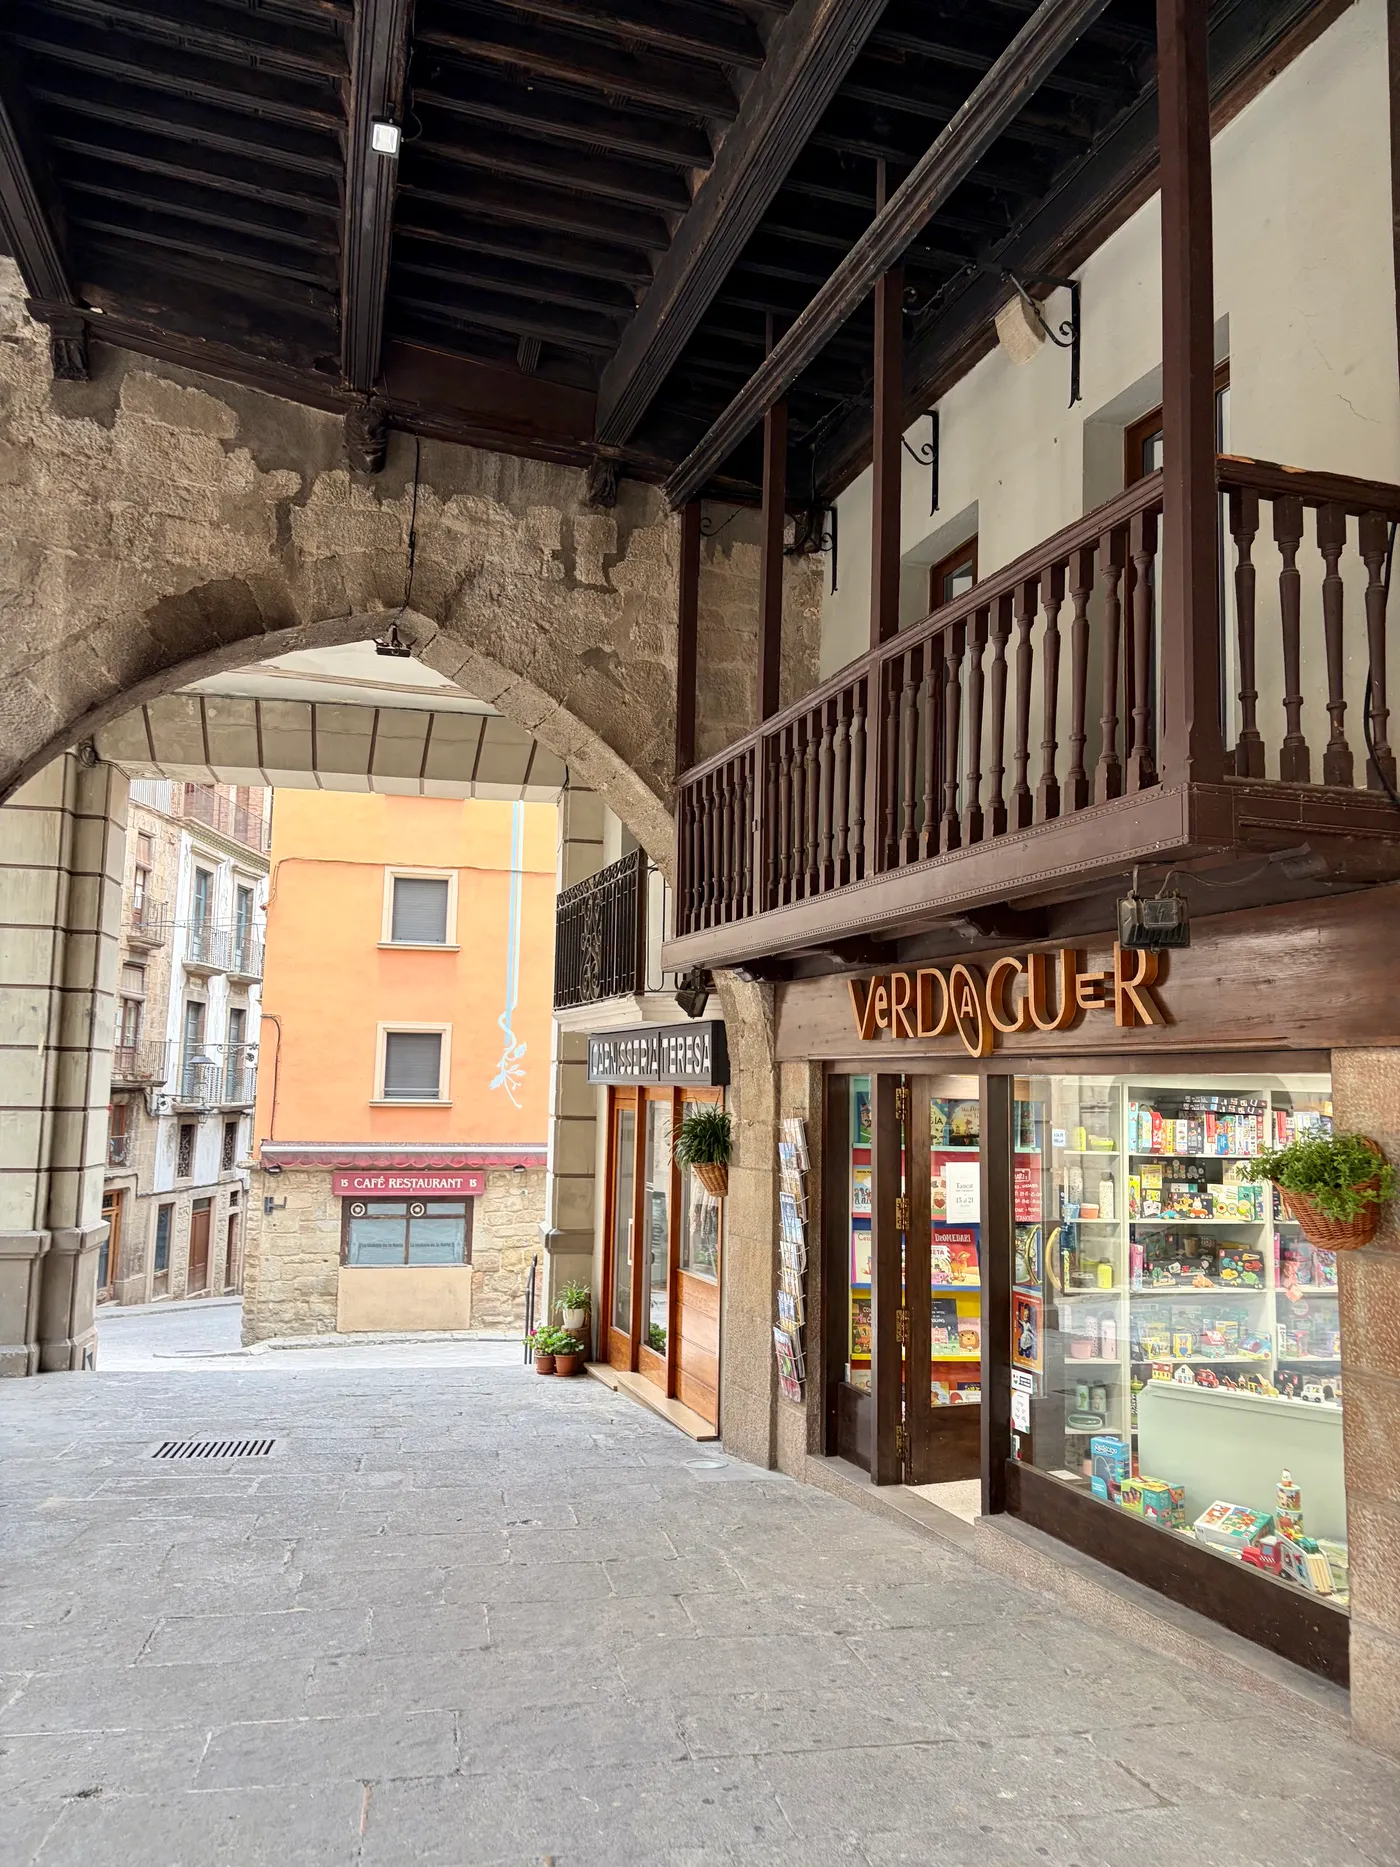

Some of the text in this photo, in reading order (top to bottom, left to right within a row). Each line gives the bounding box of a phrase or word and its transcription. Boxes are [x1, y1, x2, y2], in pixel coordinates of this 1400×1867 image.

[592, 1034, 711, 1075] CARNISSERIA TERESA
[354, 1176, 385, 1189] CAFÉ
[388, 1178, 463, 1189] RESTAURANT
